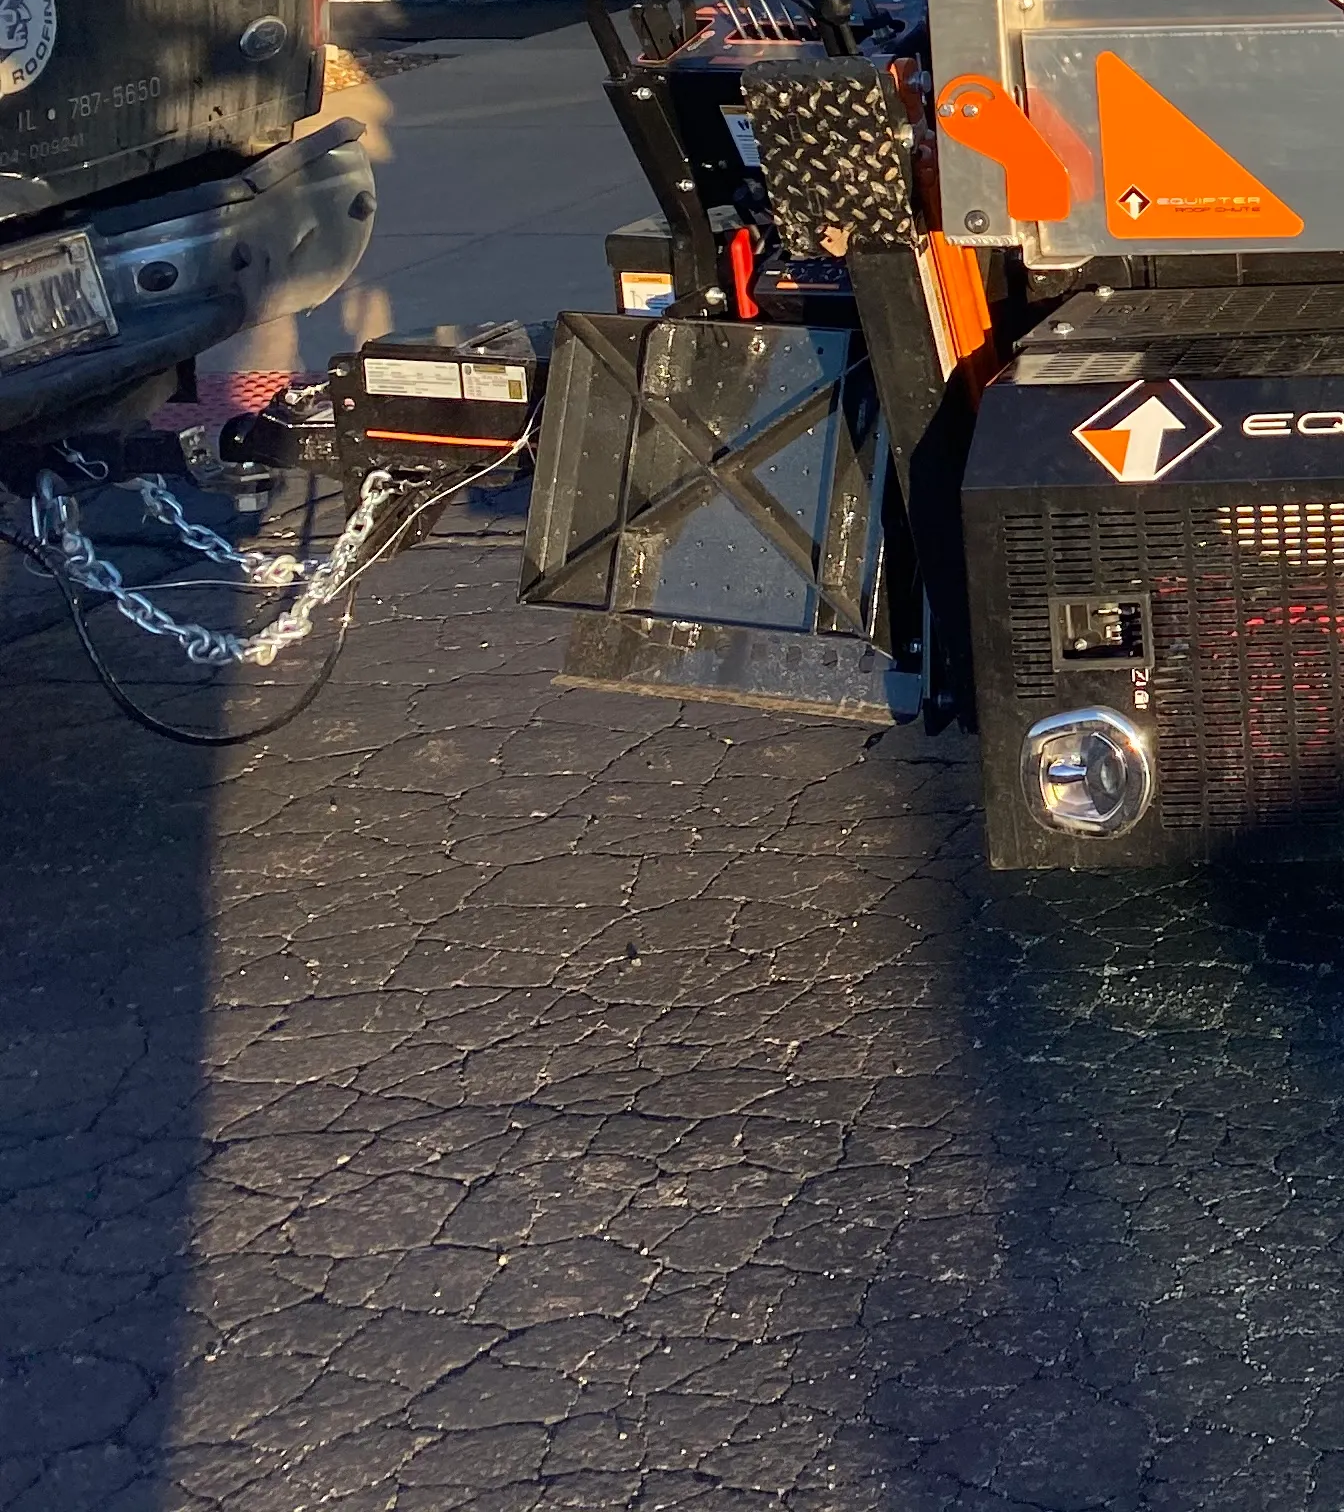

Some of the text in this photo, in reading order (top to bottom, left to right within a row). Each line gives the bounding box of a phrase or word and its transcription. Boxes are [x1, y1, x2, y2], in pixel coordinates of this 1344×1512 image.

[18, 76, 161, 133] IL 787-5650
[1156, 197, 1261, 206] EQUIPTER
